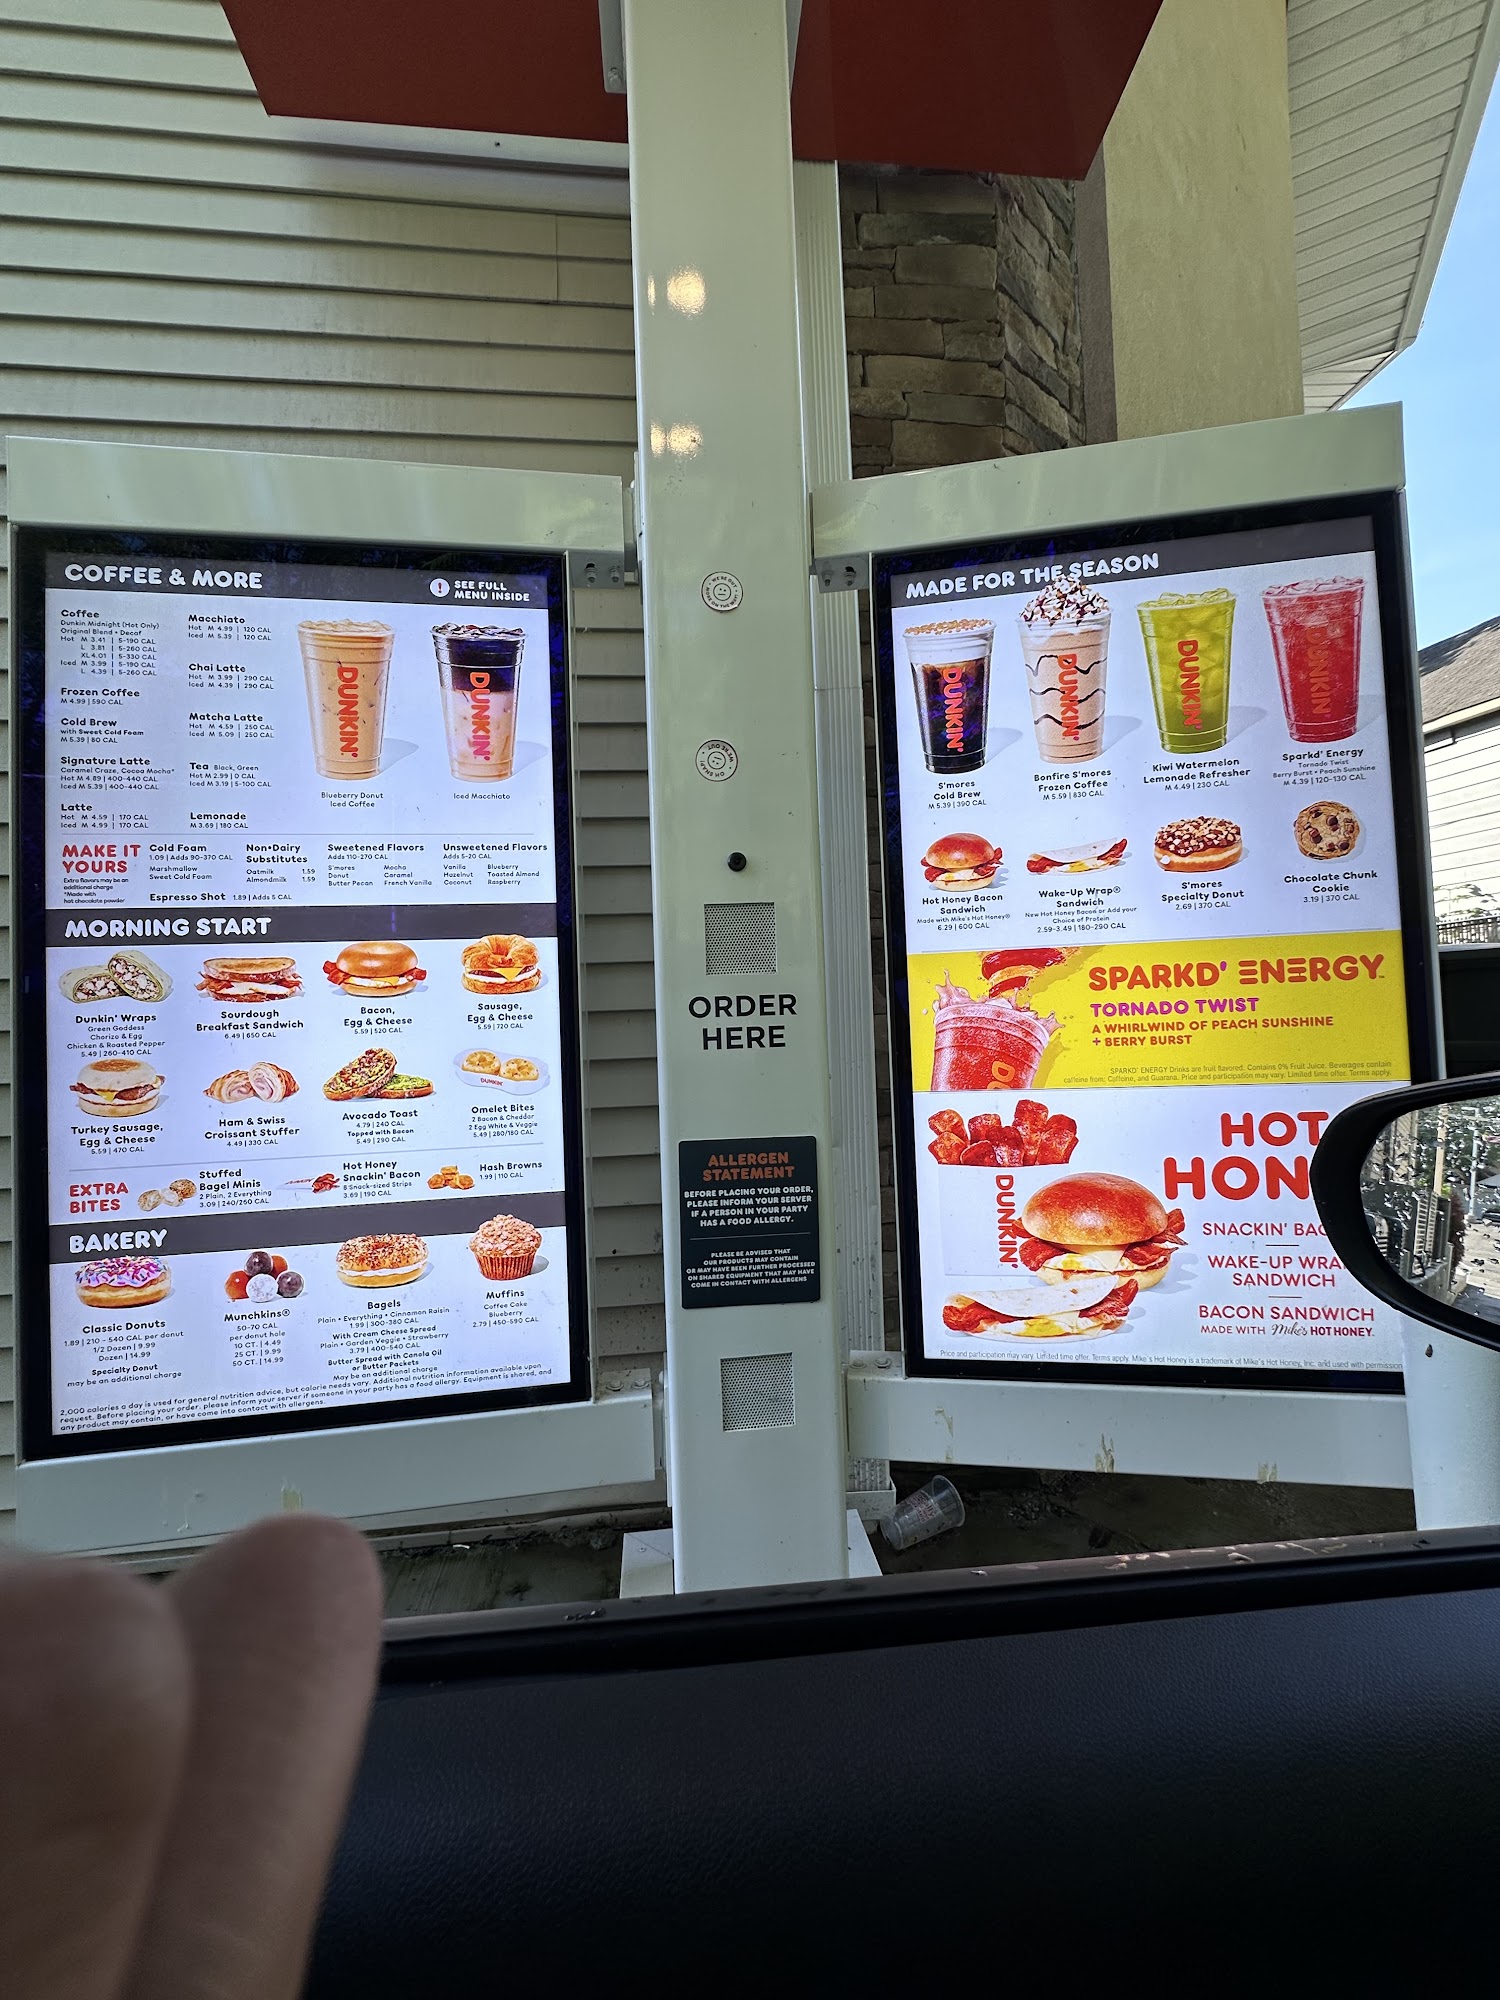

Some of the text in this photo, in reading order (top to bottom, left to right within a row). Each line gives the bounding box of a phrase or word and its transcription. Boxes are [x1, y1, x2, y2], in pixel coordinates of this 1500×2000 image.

[65, 564, 262, 589] COFFEE & MORE
[906, 552, 1159, 600] MADE FOR THE SEASON
[455, 581, 506, 590] SEE FULL
[454, 591, 529, 601] MENU INSIDE
[61, 609, 99, 618] Coffee
[189, 615, 245, 623] Macchiato
[189, 664, 246, 673] Chai Latte
[61, 688, 140, 697] Frozen Coffee
[61, 718, 117, 727] Cold Brew
[190, 713, 263, 722] Matcha Latte
[1282, 747, 1363, 762] Sparkd' Energy
[61, 757, 150, 766] Signature Latte
[1152, 758, 1239, 772] Kiwi Watermelon
[1034, 768, 1111, 781] Bonfire S'mores
[1144, 768, 1250, 785] Lemonade Refresher
[938, 781, 975, 790] S'mores
[1039, 779, 1108, 792] Frozen Coffee
[934, 789, 981, 800] Cold Brew
[190, 812, 246, 820] Lemonade
[63, 845, 141, 858] MAKE IT
[150, 844, 174, 852] Cold
[328, 843, 424, 852] Sweetened Flavors
[444, 843, 547, 851] Unsweetened Flavors
[247, 855, 307, 863] Substitutes
[63, 861, 128, 874] YOURS
[1284, 870, 1377, 884] Chocolate Chunk
[1181, 880, 1222, 890] S'mores
[1313, 883, 1349, 893] Cookie
[150, 893, 225, 903] Espresso Shot
[922, 892, 1003, 905] Hot Honey Bacon
[1039, 888, 1082, 899] Wake-Up
[1161, 890, 1244, 903] Specialty Donut
[1056, 897, 1103, 907] Sandwich
[940, 904, 985, 914] Sandwich
[65, 917, 271, 938] MORNING START
[1089, 962, 1227, 992] SPARKD'
[361, 1007, 395, 1015] Bacon,
[478, 1002, 522, 1012] Sausage,
[688, 994, 797, 1018] ORDER
[1091, 998, 1259, 1017] TORNADO TWIST
[76, 1014, 156, 1024] Dunkin' Wraps
[221, 1010, 279, 1019] Sourdough
[197, 1021, 303, 1031] Breakfast Sandwich
[1092, 1016, 1333, 1034] A WHIRLWIND OF PEACH SUNSHINE
[702, 1026, 786, 1050] HERE
[1105, 1035, 1147, 1047] BERRY
[1150, 1034, 1192, 1046] BURST
[343, 1109, 418, 1120] Avocado Toast
[471, 1104, 535, 1114] Omelet Bites
[205, 1127, 299, 1140] Croissant Stuffer
[1221, 1112, 1329, 1147] HOT
[708, 1152, 789, 1167] ALLERGEN
[343, 1160, 397, 1171] Hot Honey
[480, 1161, 542, 1172] Hash Browns
[343, 1170, 421, 1182] Snackin' Bacon
[703, 1166, 794, 1181] STATEMENT
[1164, 1156, 1310, 1201] HON
[69, 1183, 128, 1197] EXTRA
[684, 1190, 716, 1198] BEFORE
[783, 1186, 813, 1195] ORDER,
[69, 1199, 121, 1213] BITES
[1203, 1222, 1326, 1237] SNACKIN' BAC
[70, 1229, 168, 1254] BAKERY
[1208, 1256, 1345, 1271] WAKE-UP WRA
[1233, 1272, 1335, 1287] SANDWICH
[486, 1290, 525, 1299] Muffins
[367, 1300, 401, 1310] Bagels
[1199, 1305, 1374, 1321] BACON SANDWICH
[83, 1320, 166, 1334] Classic Donuts
[1201, 1325, 1233, 1334] MADE
[1237, 1325, 1265, 1334] WITH
[1310, 1326, 1332, 1335] HOT
